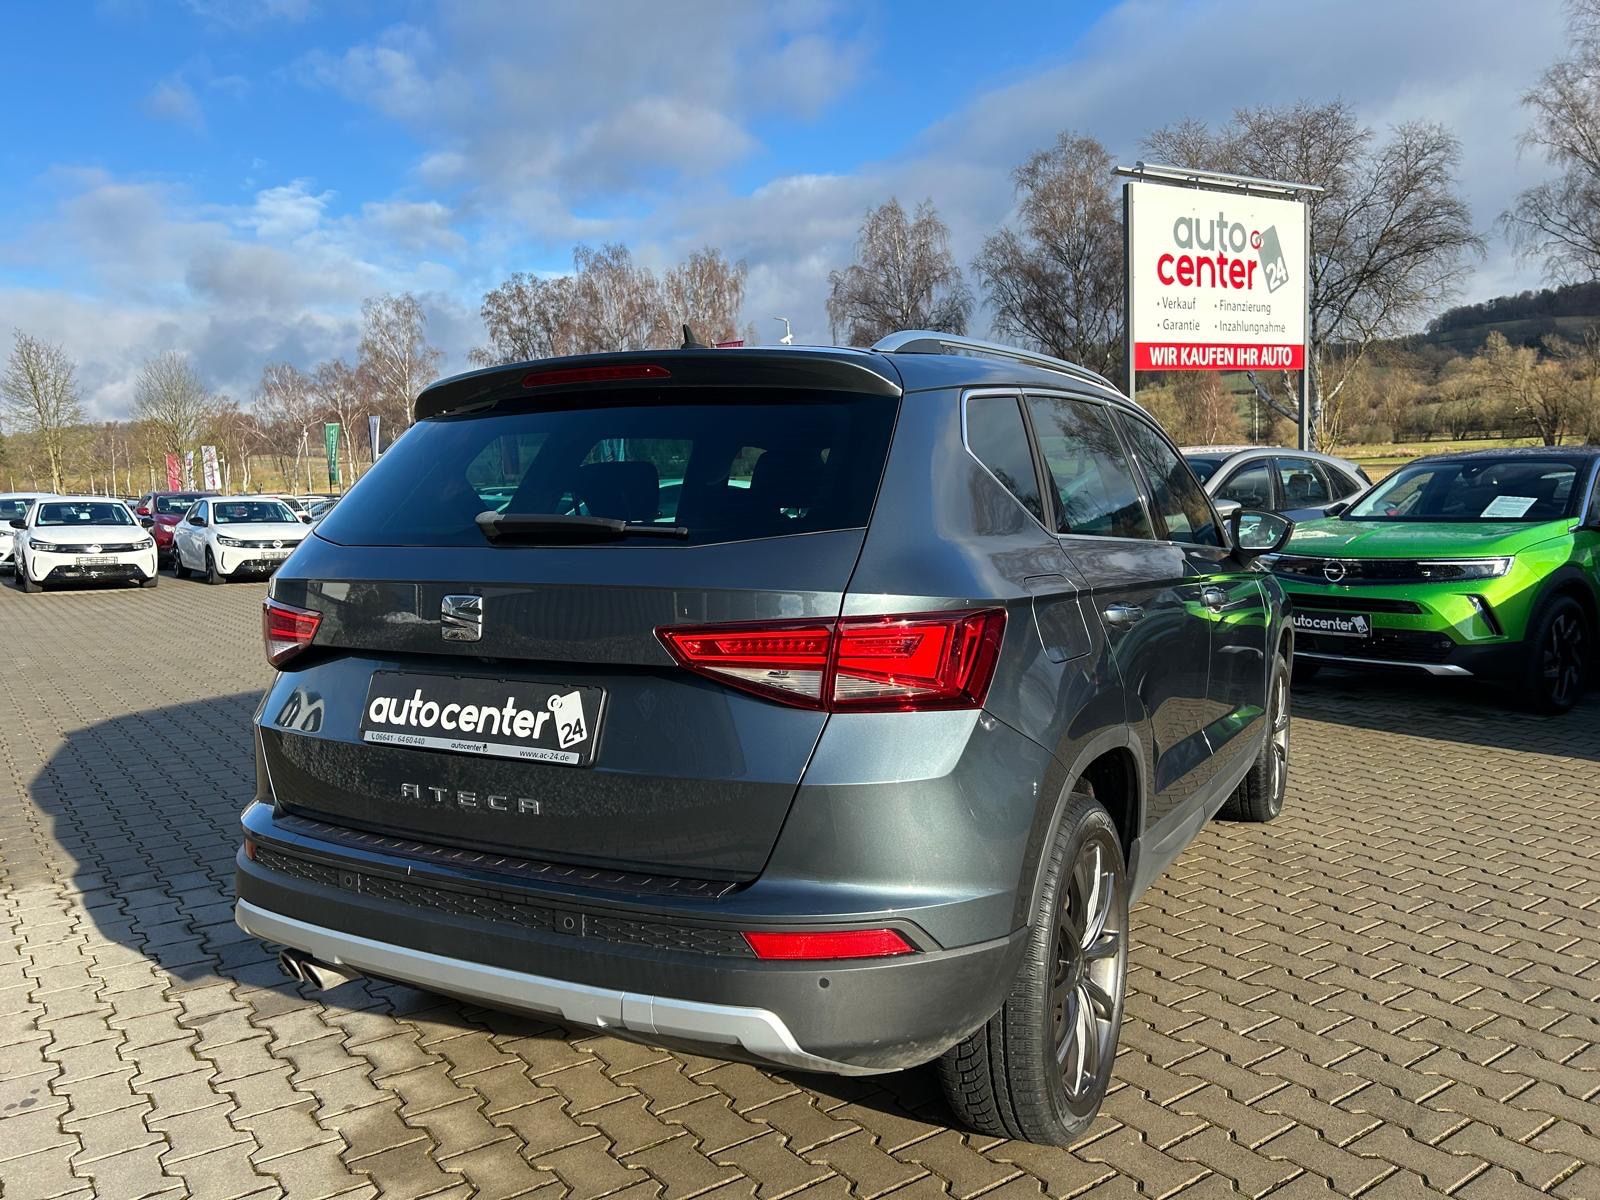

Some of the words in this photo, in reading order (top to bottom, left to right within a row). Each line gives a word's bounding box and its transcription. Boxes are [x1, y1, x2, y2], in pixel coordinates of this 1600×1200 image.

[1173, 211, 1247, 253] auto
[1157, 252, 1257, 290] center
[1265, 257, 1287, 289] 24
[1162, 297, 1196, 311] Verkauf
[1219, 299, 1272, 316] Finanzierung
[1162, 318, 1201, 331] Garantie
[1219, 320, 1286, 335] Inzahlungnahme
[1149, 346, 1178, 366] WIR
[1180, 347, 1235, 366] KAUFEN
[1236, 347, 1259, 366] IHR
[1260, 346, 1293, 367] AUTO
[1293, 614, 1354, 631] utocenter
[368, 688, 550, 740] autocenter
[560, 718, 584, 745] 24
[450, 742, 482, 752] autocenter
[519, 750, 570, 762] www.ac-24.de
[400, 783, 540, 815] ATECA
